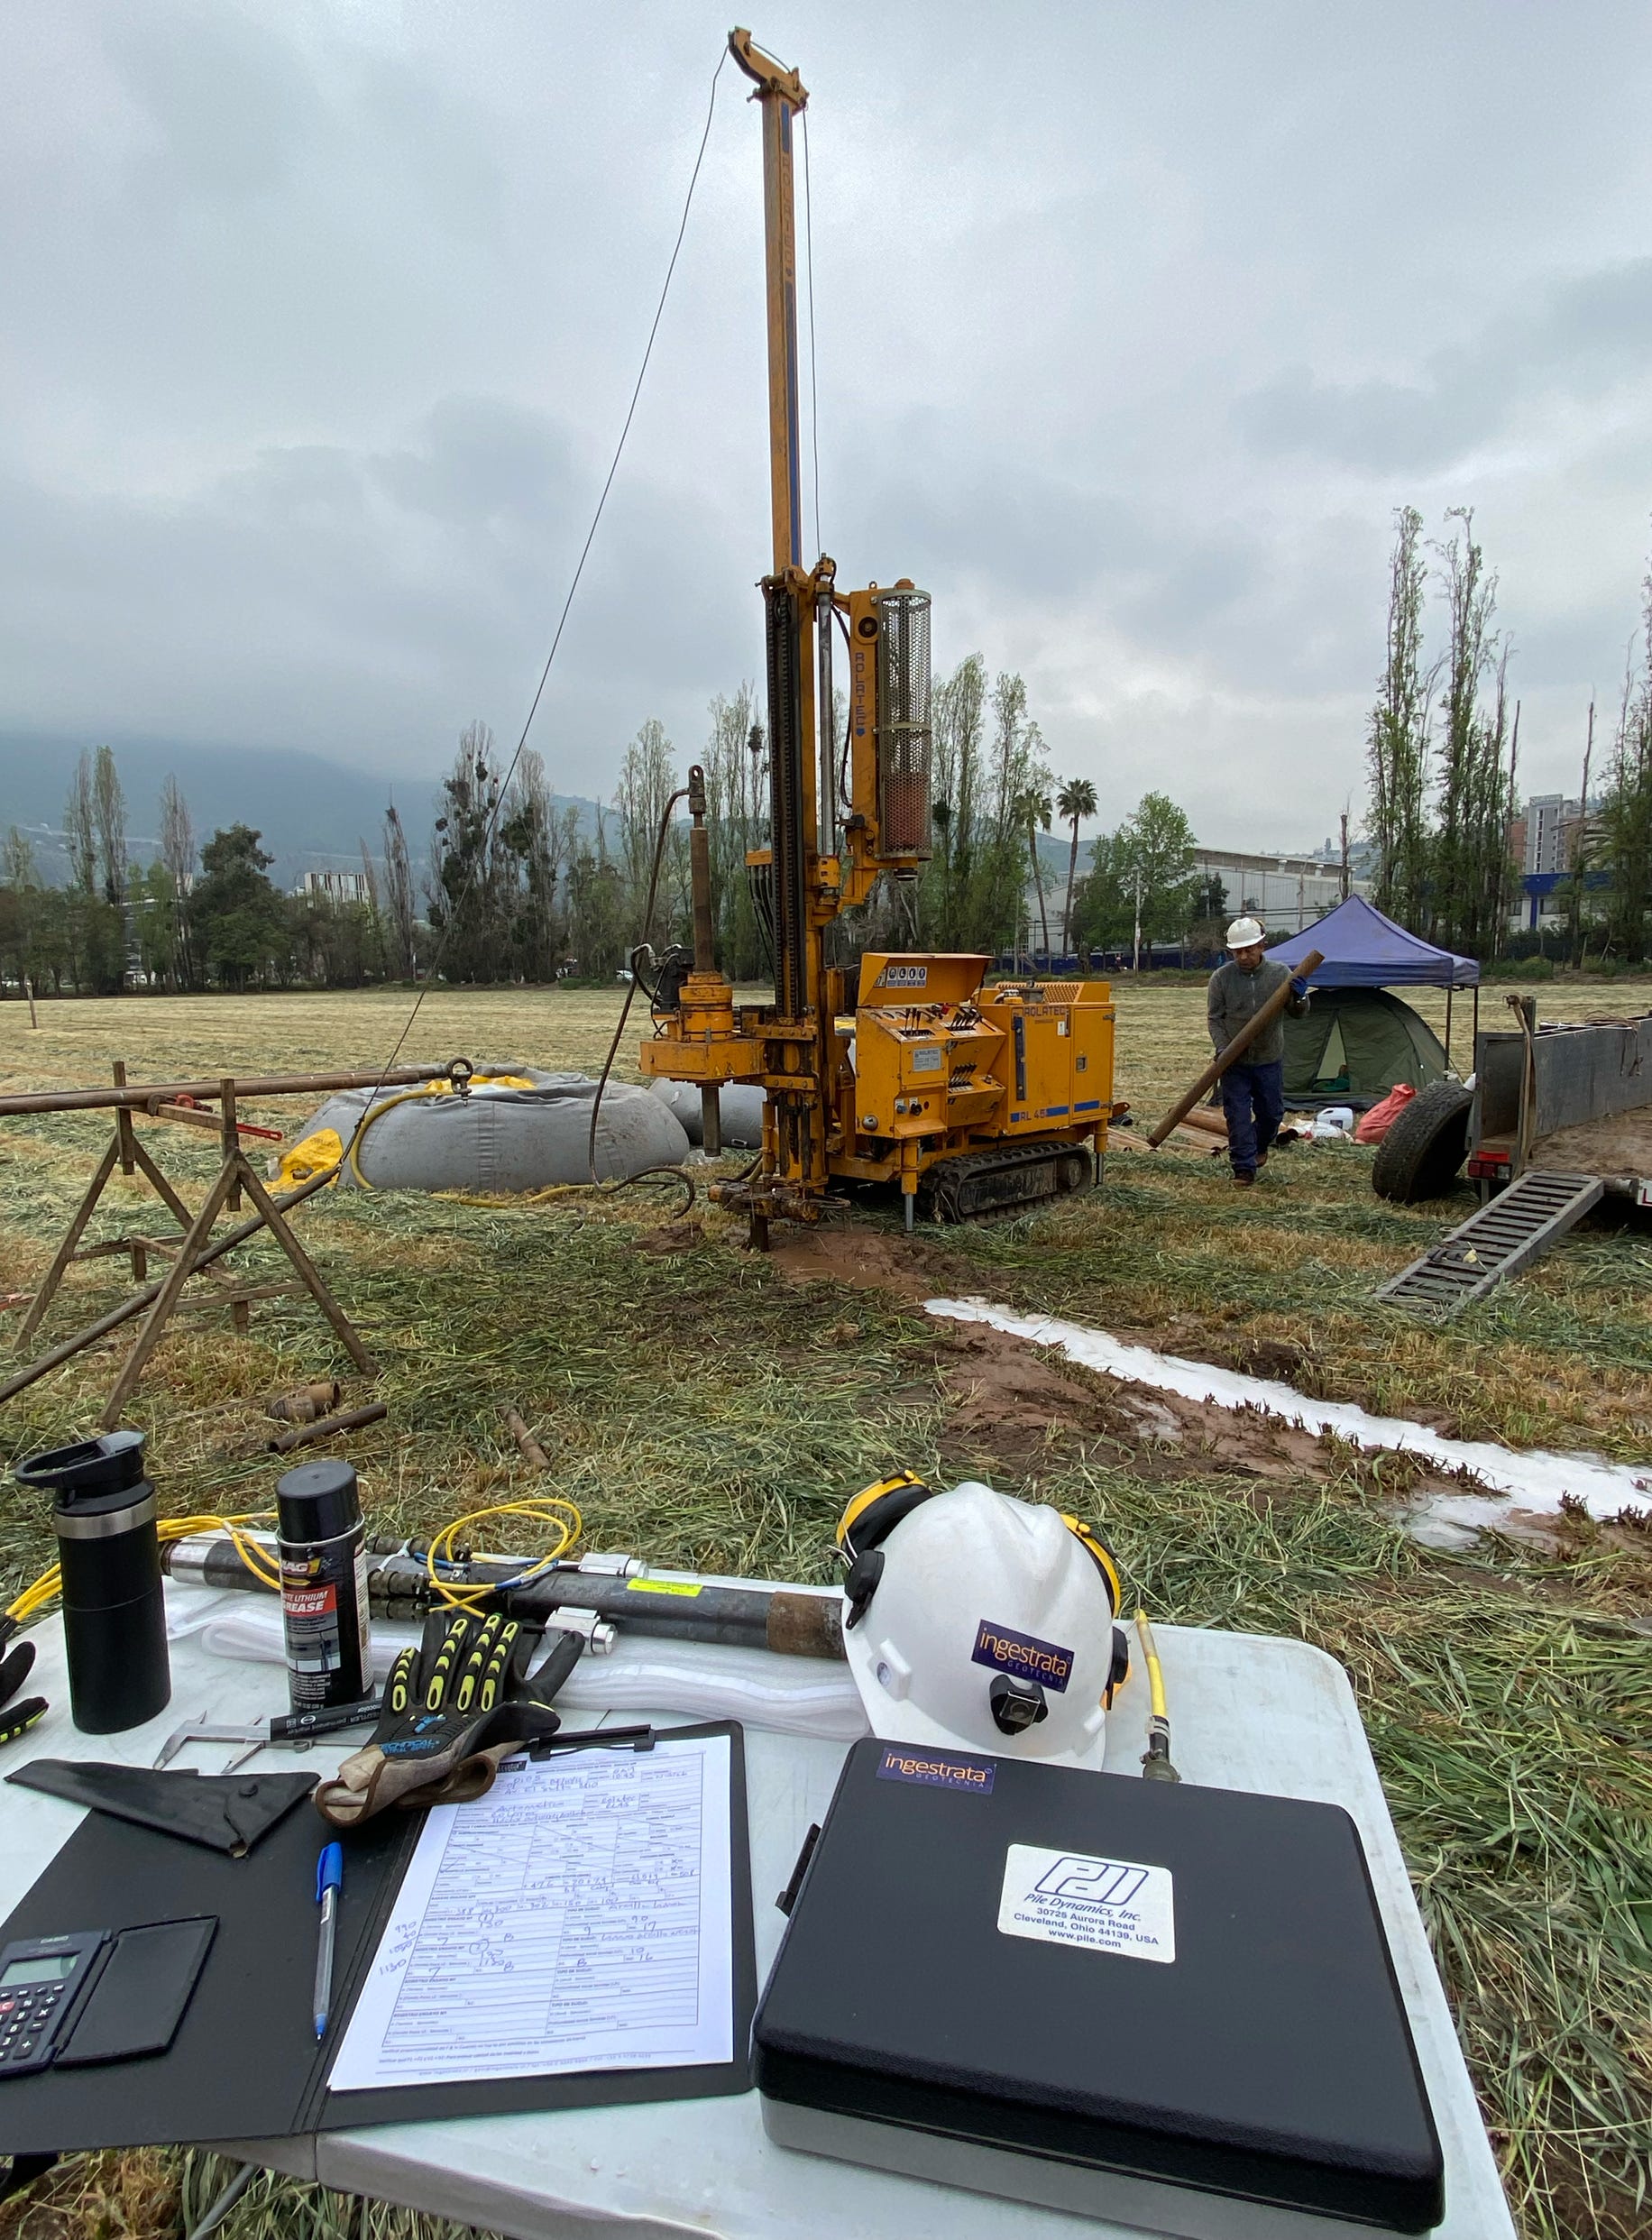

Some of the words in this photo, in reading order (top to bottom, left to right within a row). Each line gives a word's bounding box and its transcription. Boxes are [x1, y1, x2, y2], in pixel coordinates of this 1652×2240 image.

[855, 652, 866, 725] ROLATEC
[294, 1590, 328, 1603] LITHIUM
[979, 1627, 1068, 1677] ingestrata
[886, 1753, 987, 1783] ingestrata
[915, 1773, 985, 1788] GEOTECNIA
[1023, 1893, 1048, 1905] Pile
[1049, 1897, 1115, 1918] Dynamics,
[1118, 1909, 1142, 1923] Inc.
[1037, 1907, 1068, 1920] 30725
[1070, 1913, 1106, 1926] Aurora
[1108, 1919, 1136, 1932] Road
[1014, 1913, 1069, 1930] Cleveland,
[1070, 1922, 1096, 1934] Ohio
[1098, 1926, 1133, 1942] 44139,
[1135, 1933, 1160, 1946] USA
[1049, 1929, 1122, 1949] www.pile.com
